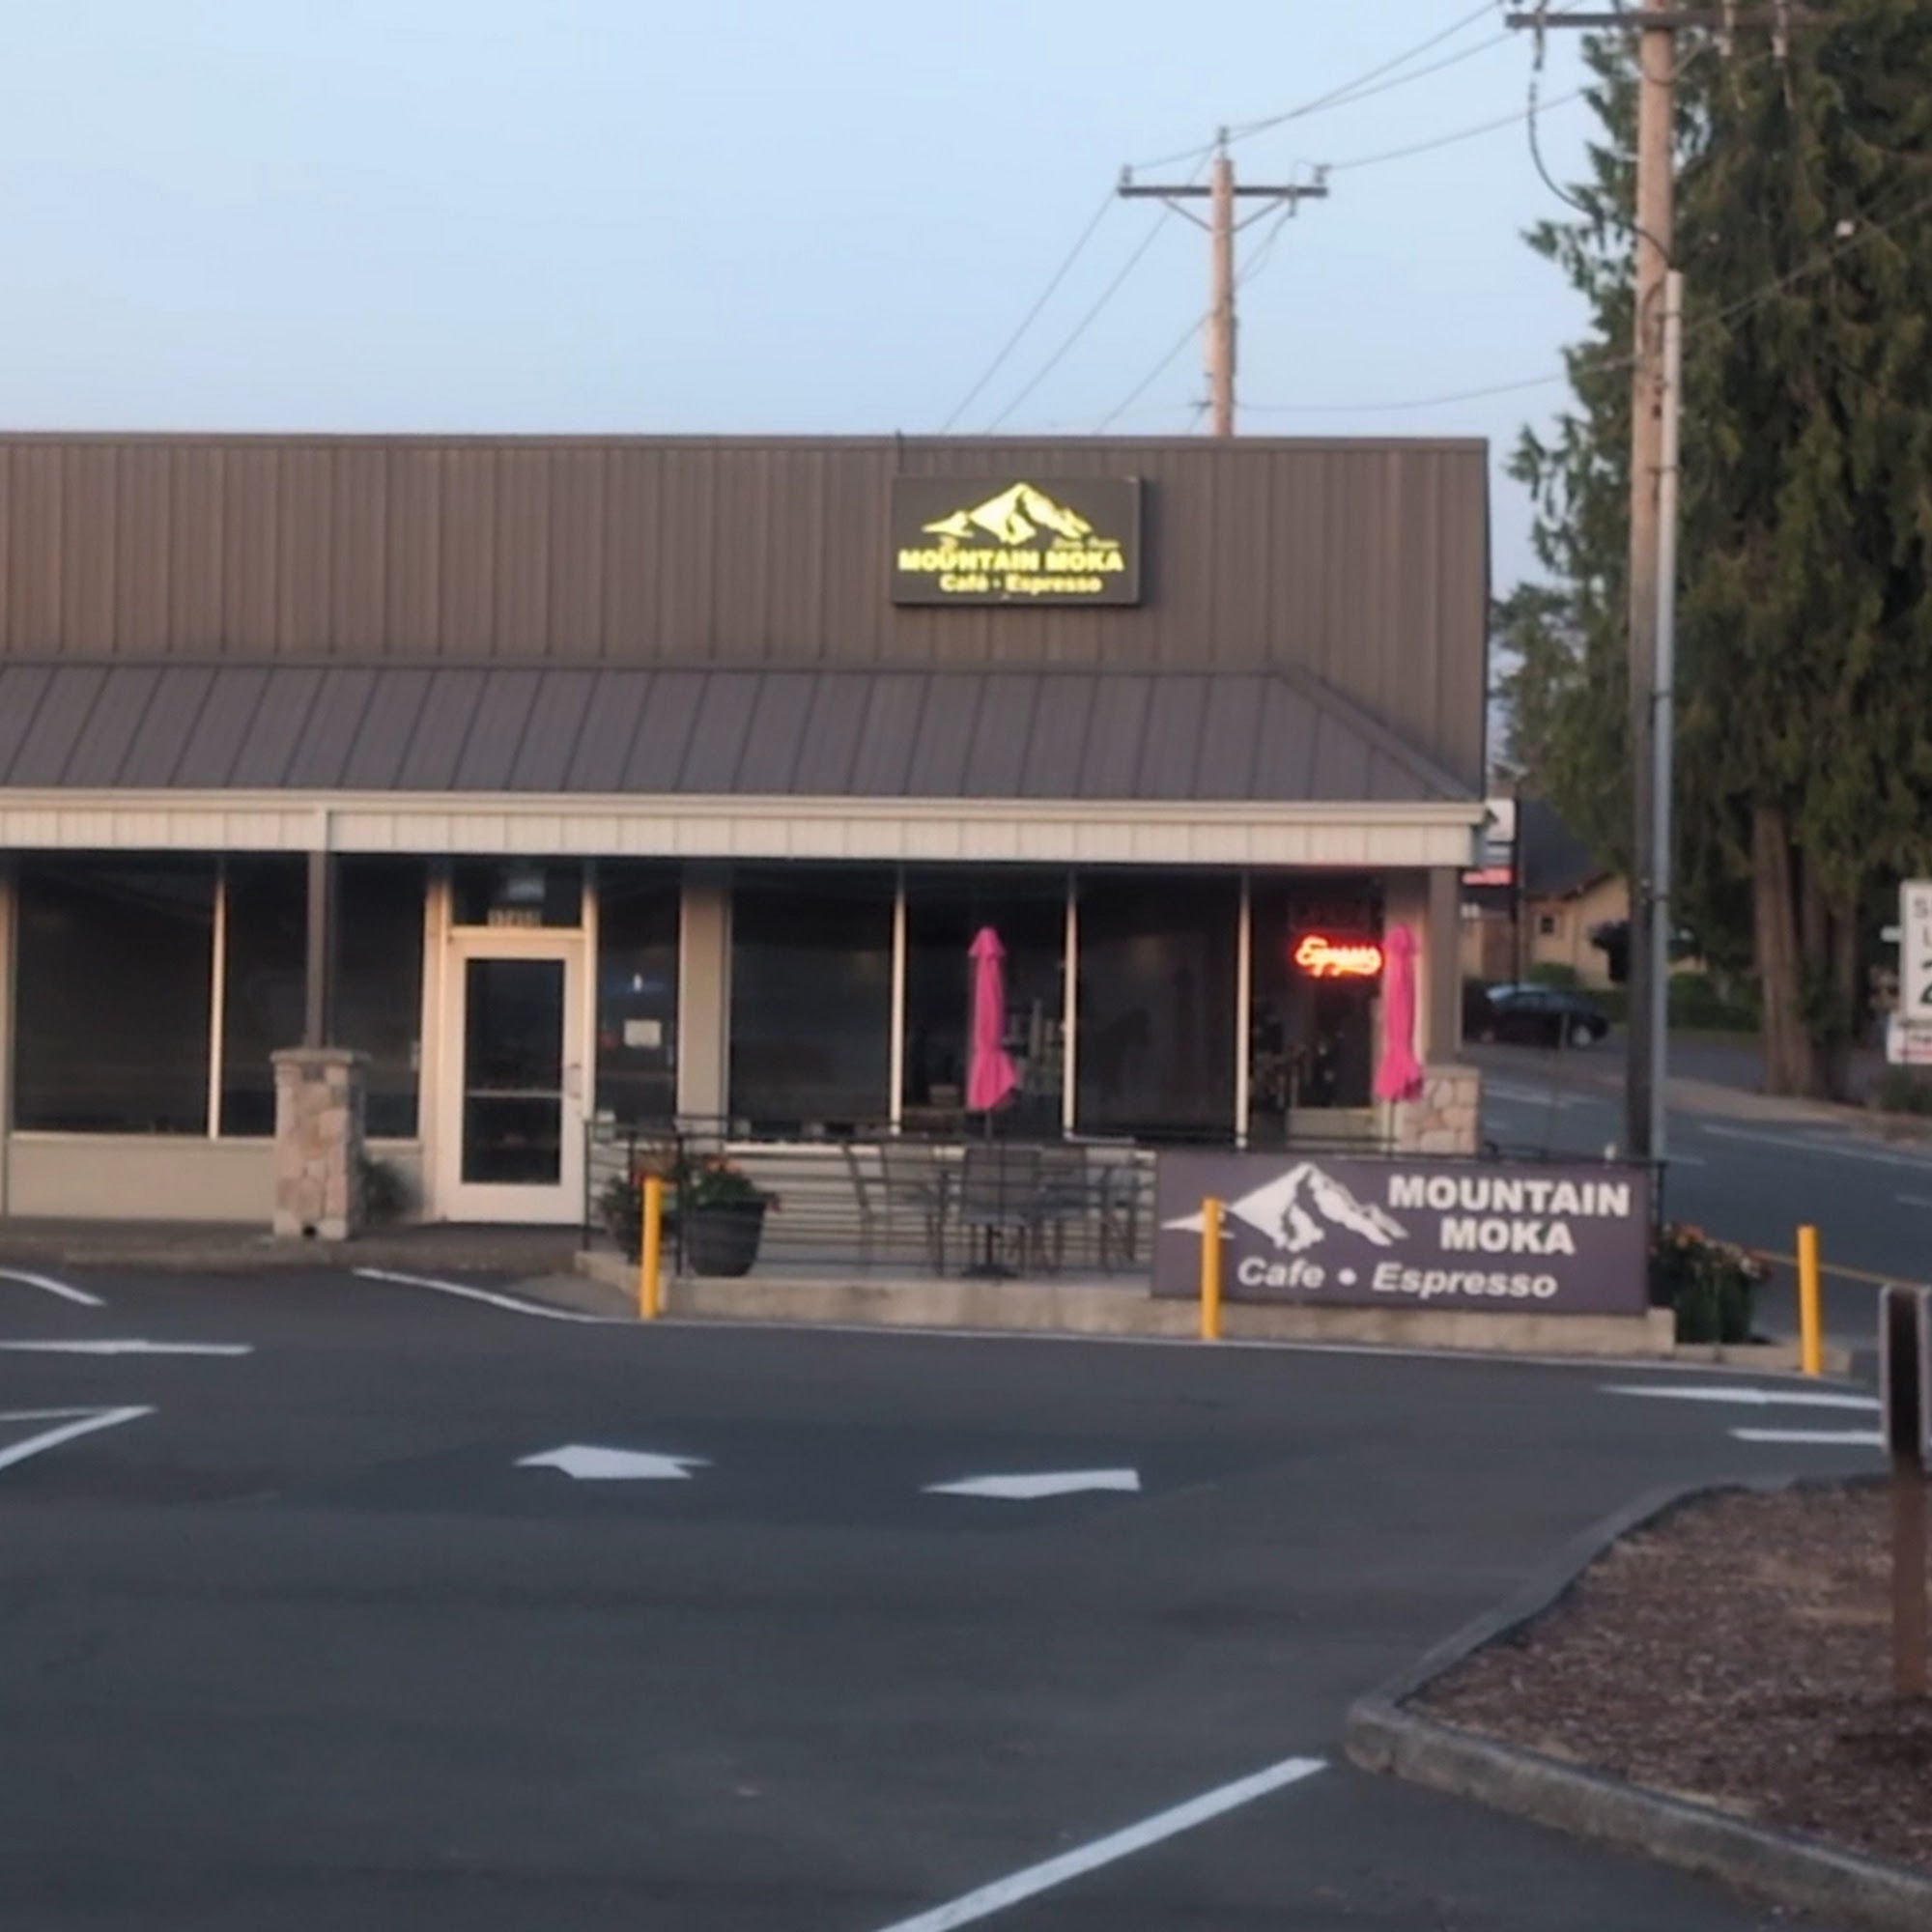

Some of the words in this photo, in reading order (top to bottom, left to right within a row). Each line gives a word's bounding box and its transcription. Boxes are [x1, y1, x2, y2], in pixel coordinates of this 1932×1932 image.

[898, 551, 1038, 571] MOUNTAIN
[1045, 551, 1123, 571] MOKA
[1006, 574, 1102, 594] Espresso
[1389, 1175, 1630, 1216] MOUNTAIN
[1440, 1217, 1576, 1255] MOKA
[1237, 1258, 1325, 1288] Cafe
[1372, 1262, 1558, 1299] Espresso
